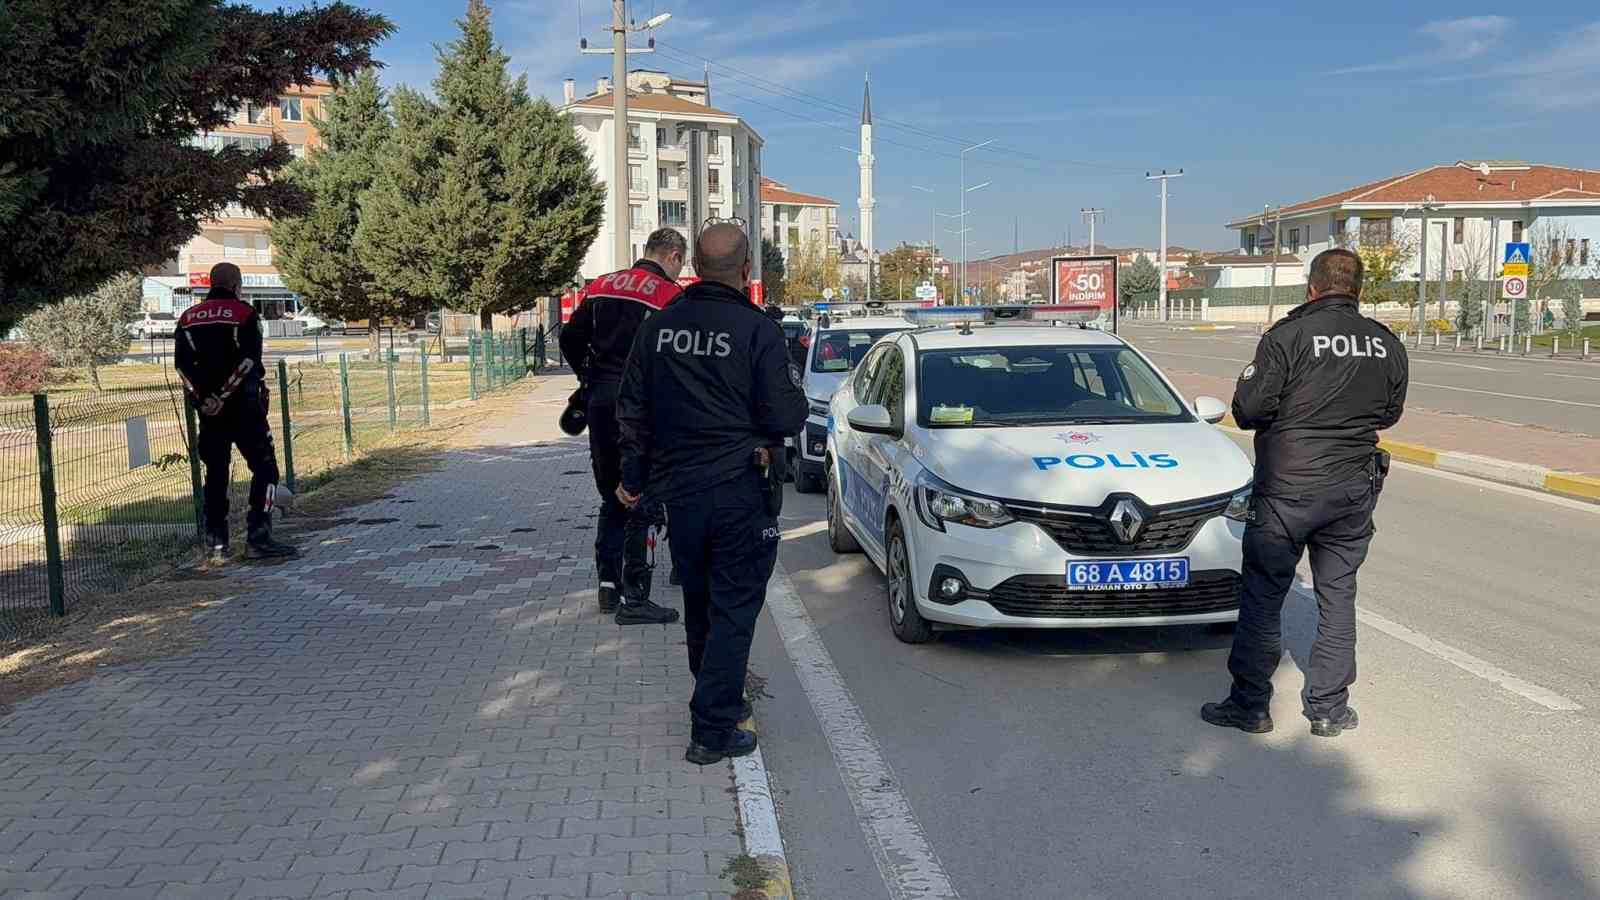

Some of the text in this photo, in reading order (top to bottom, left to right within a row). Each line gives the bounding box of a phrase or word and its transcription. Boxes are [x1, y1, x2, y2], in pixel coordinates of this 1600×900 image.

[1510, 282, 1521, 291] 30
[1031, 451, 1179, 471] POLİS
[1075, 561, 1181, 583] 68 A 4815
[1087, 584, 1121, 592] UZMAN
